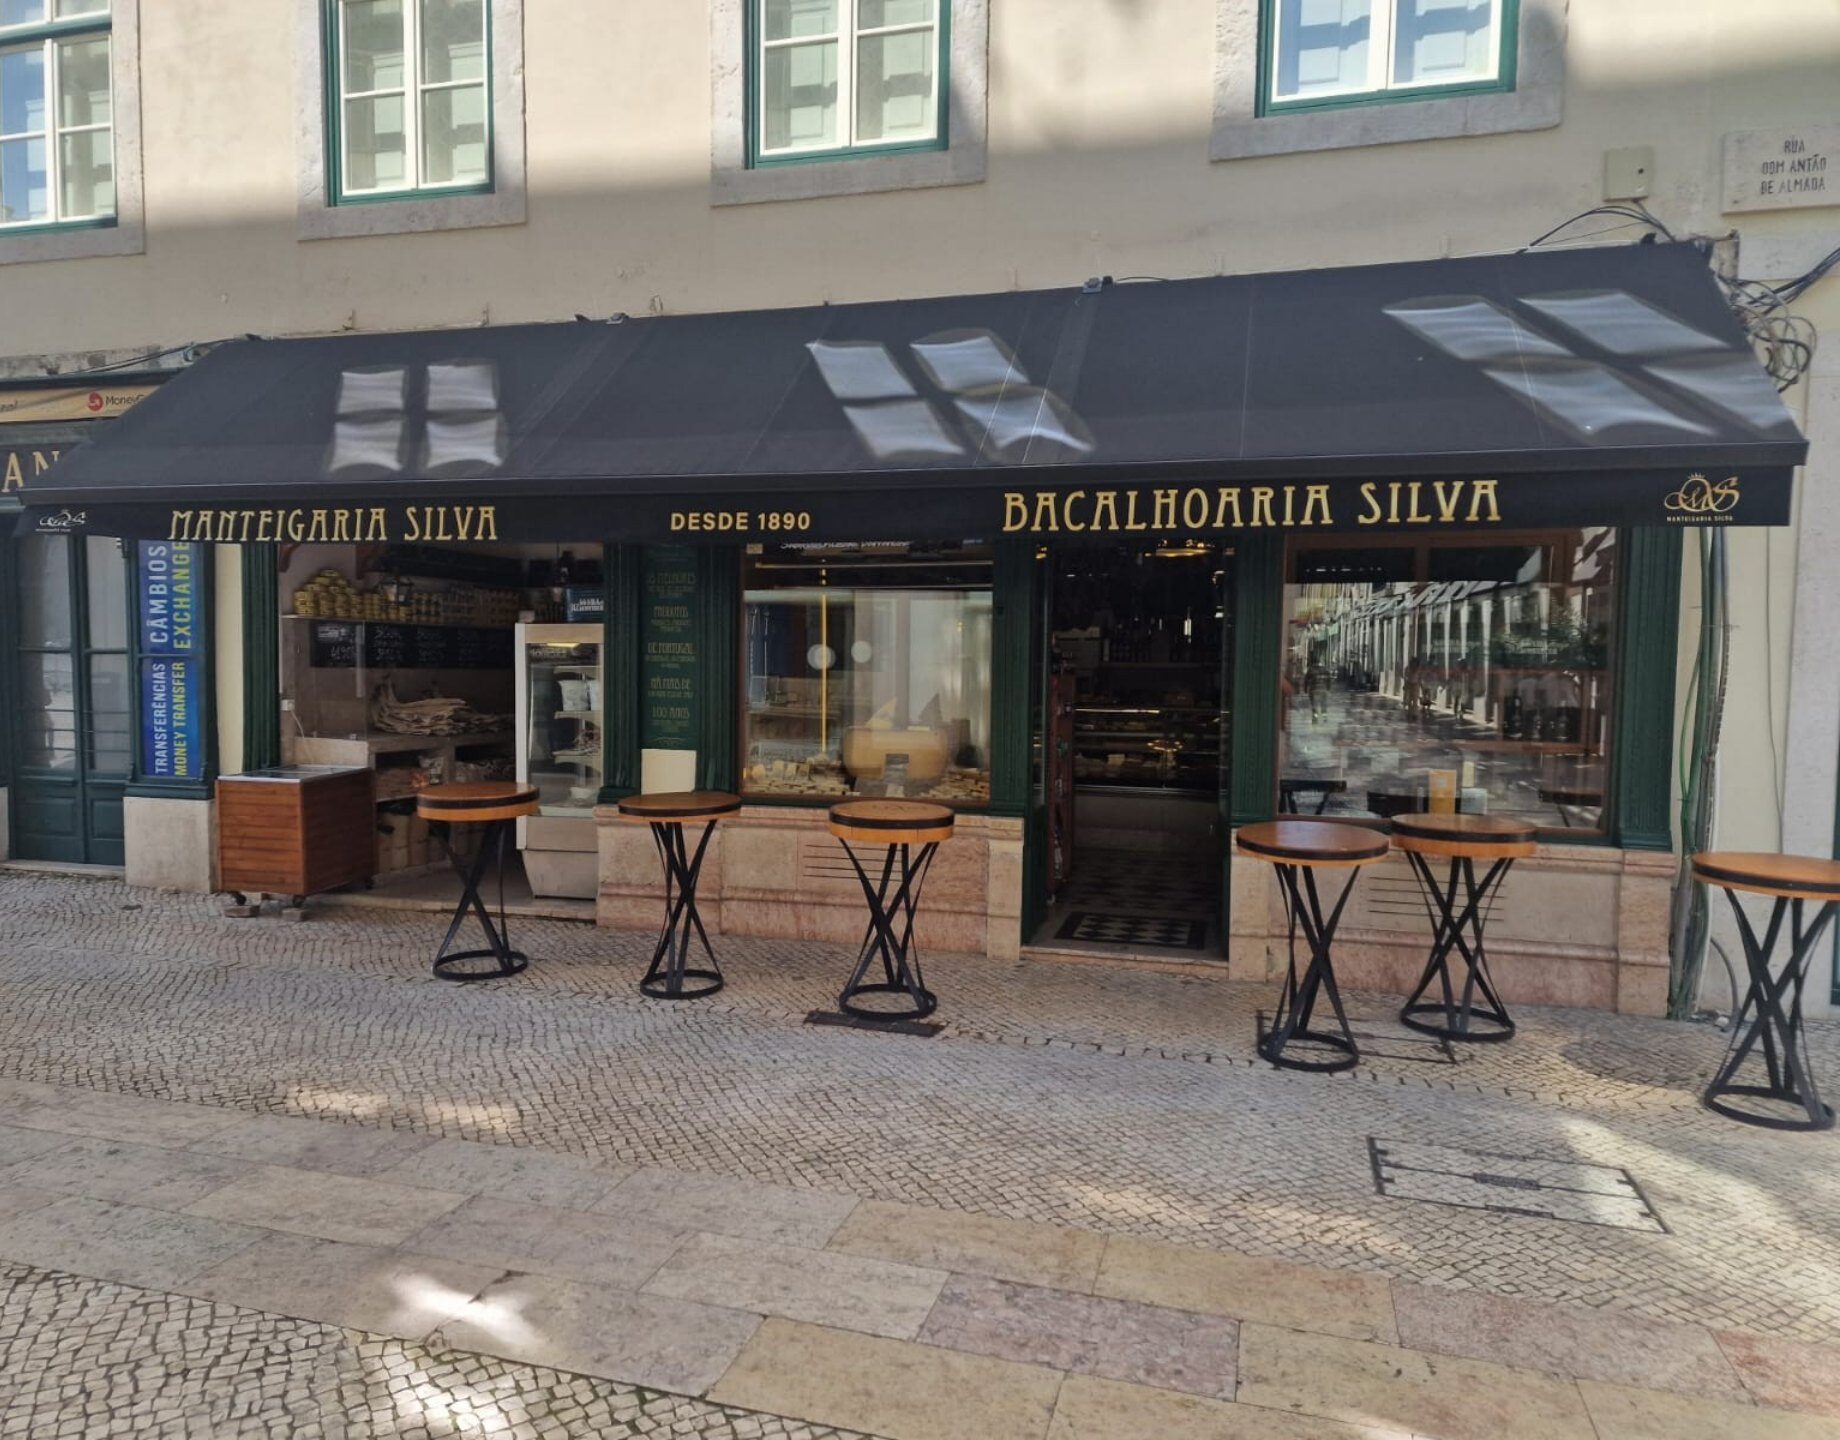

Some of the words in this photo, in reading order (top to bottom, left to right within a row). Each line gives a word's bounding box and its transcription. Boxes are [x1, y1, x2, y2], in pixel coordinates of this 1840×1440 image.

[1784, 139, 1805, 153] RUA
[1761, 180, 1775, 195] DE
[168, 508, 389, 542] MANTEIGARIA
[403, 506, 499, 541] SILVA
[670, 511, 749, 531] DESDE
[757, 511, 811, 531] 1890
[1002, 485, 1334, 533] BACALHOARIA
[1357, 480, 1502, 525] SILVA
[146, 545, 169, 644] CÂMBIOS
[171, 541, 192, 650] EXCHANGE
[171, 661, 186, 727] TRANSFER
[153, 663, 169, 775] TRANSFERÊNCIAS
[173, 731, 188, 776] MONEY
